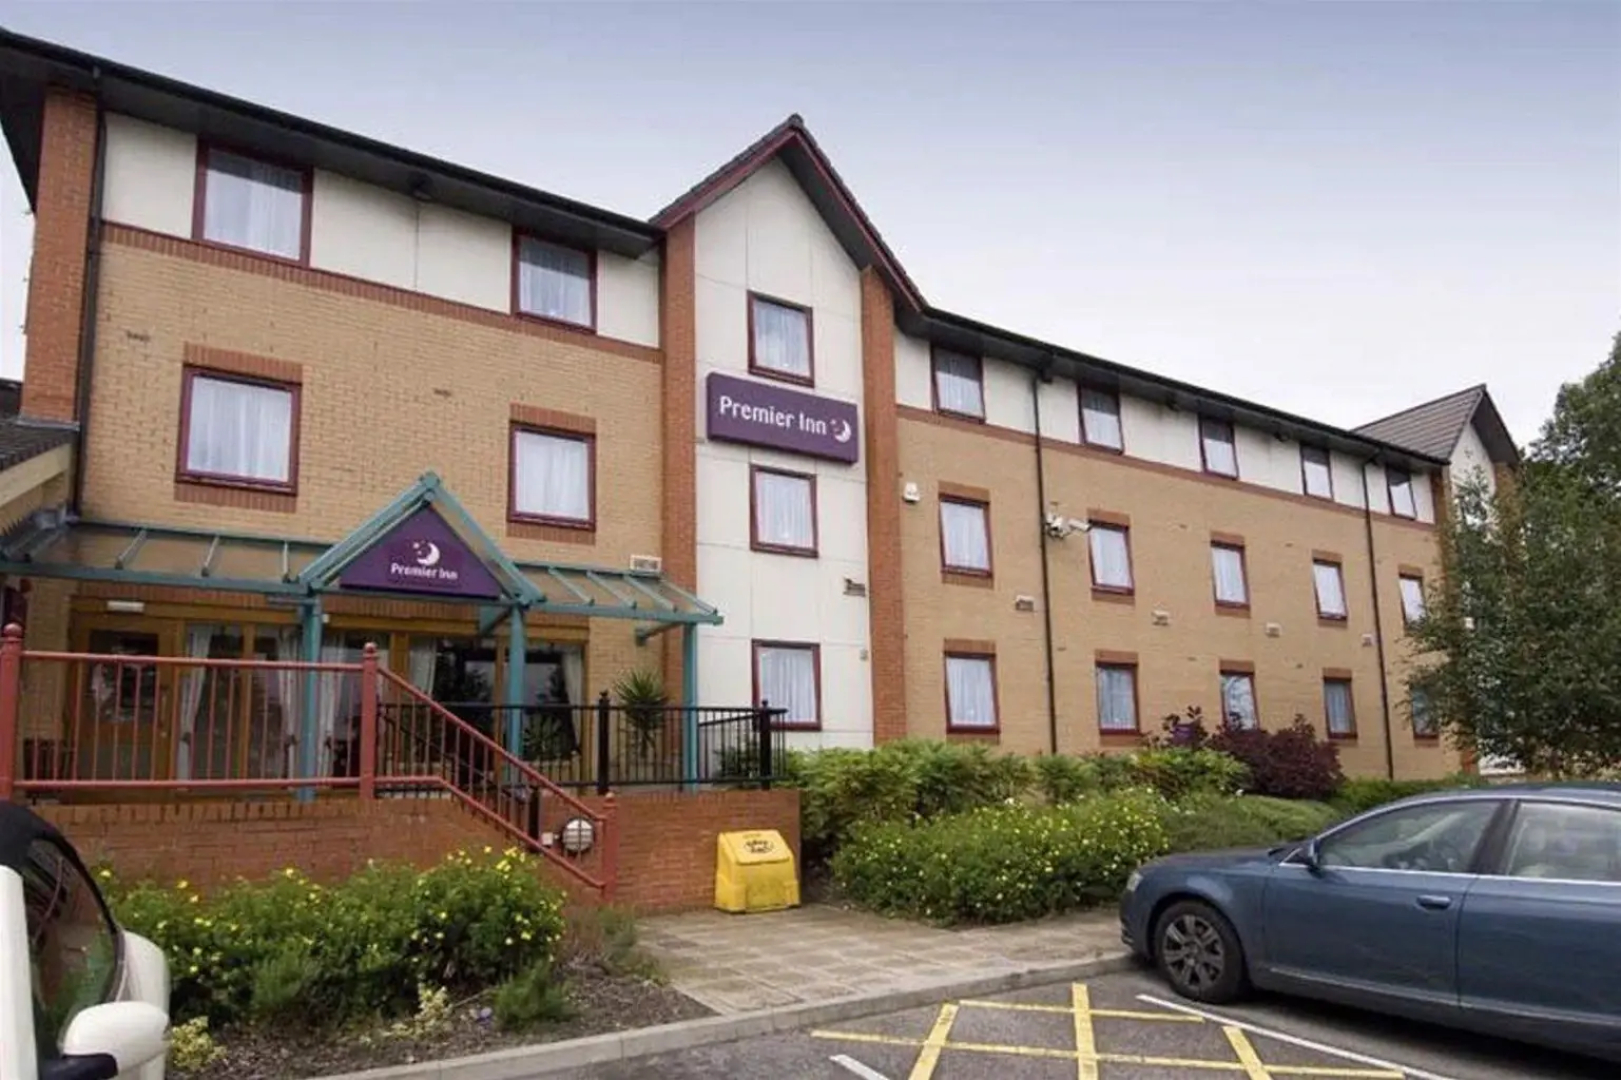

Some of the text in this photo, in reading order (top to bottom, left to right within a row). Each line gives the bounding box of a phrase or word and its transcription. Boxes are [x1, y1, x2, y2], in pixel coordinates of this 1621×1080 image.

[719, 395, 827, 435] Premier Inn
[390, 562, 458, 580] Premier Inn
